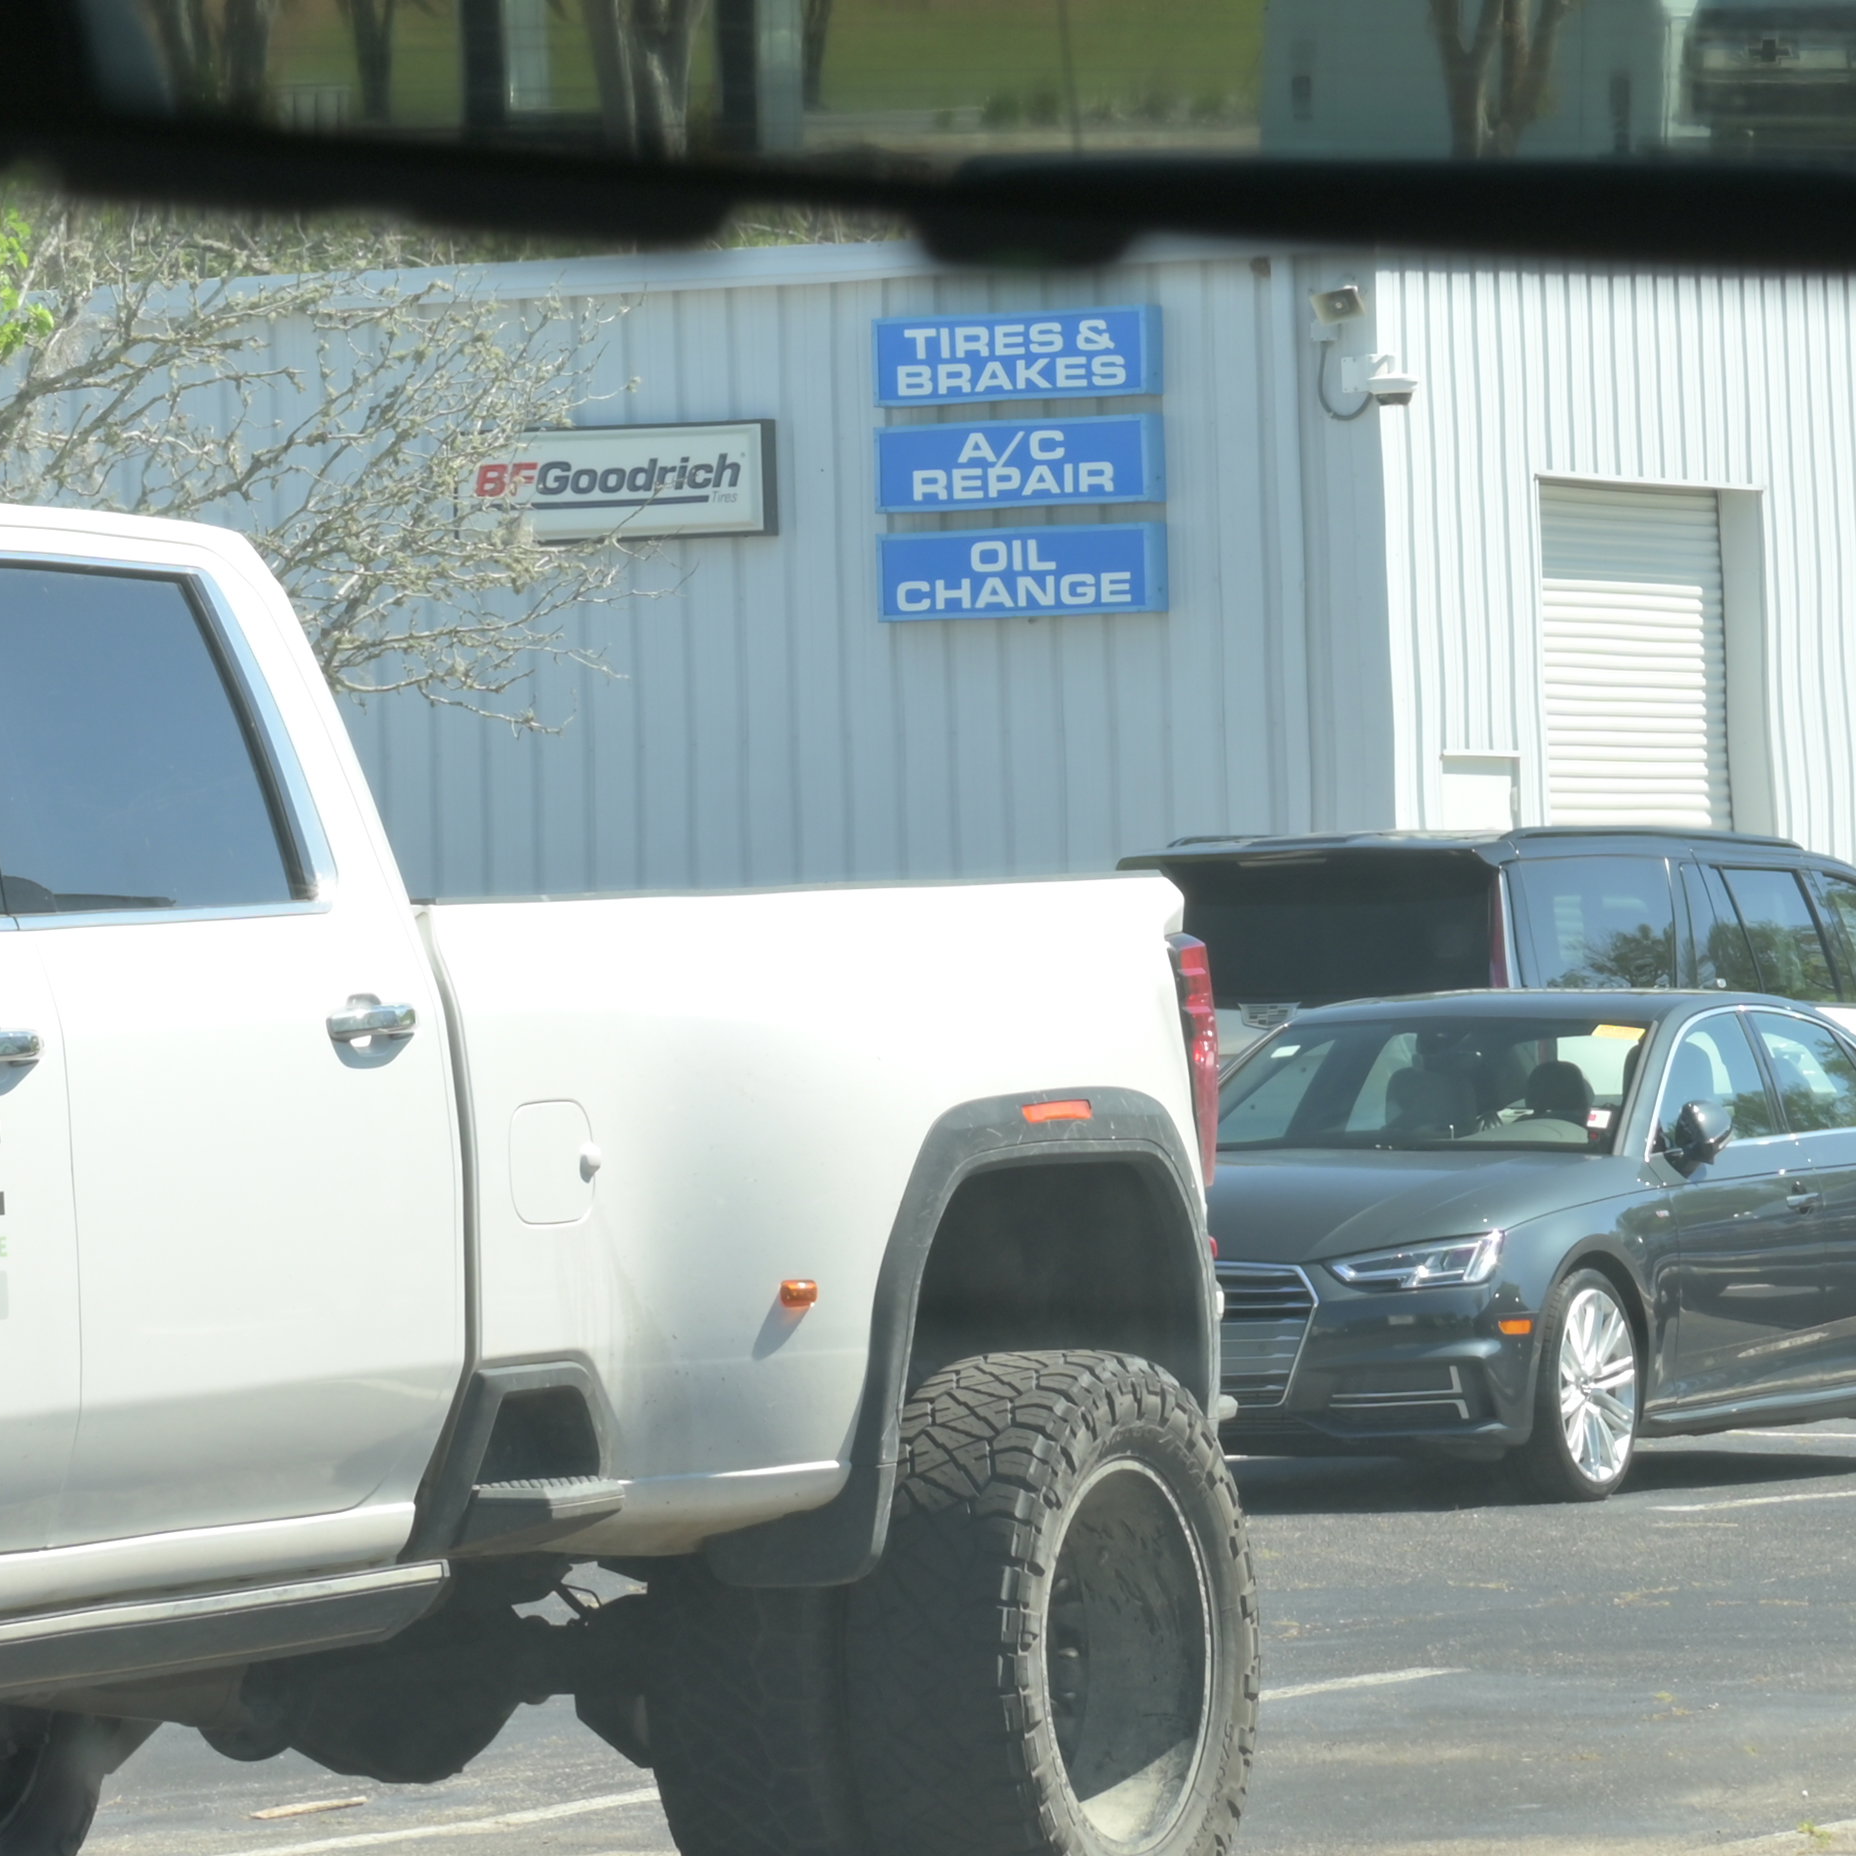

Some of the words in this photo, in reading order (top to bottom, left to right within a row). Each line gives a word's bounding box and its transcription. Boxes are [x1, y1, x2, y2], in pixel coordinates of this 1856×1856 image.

[904, 322, 1064, 360] TIRES
[1076, 319, 1116, 350] &
[897, 355, 1127, 396] BRAKES
[957, 429, 1066, 469] A/C
[475, 452, 742, 498] BFGoodrich
[913, 461, 1114, 501] REPAIR
[711, 490, 739, 504] Tires
[970, 539, 1057, 573] OIL
[896, 572, 1132, 612] CHANGE
